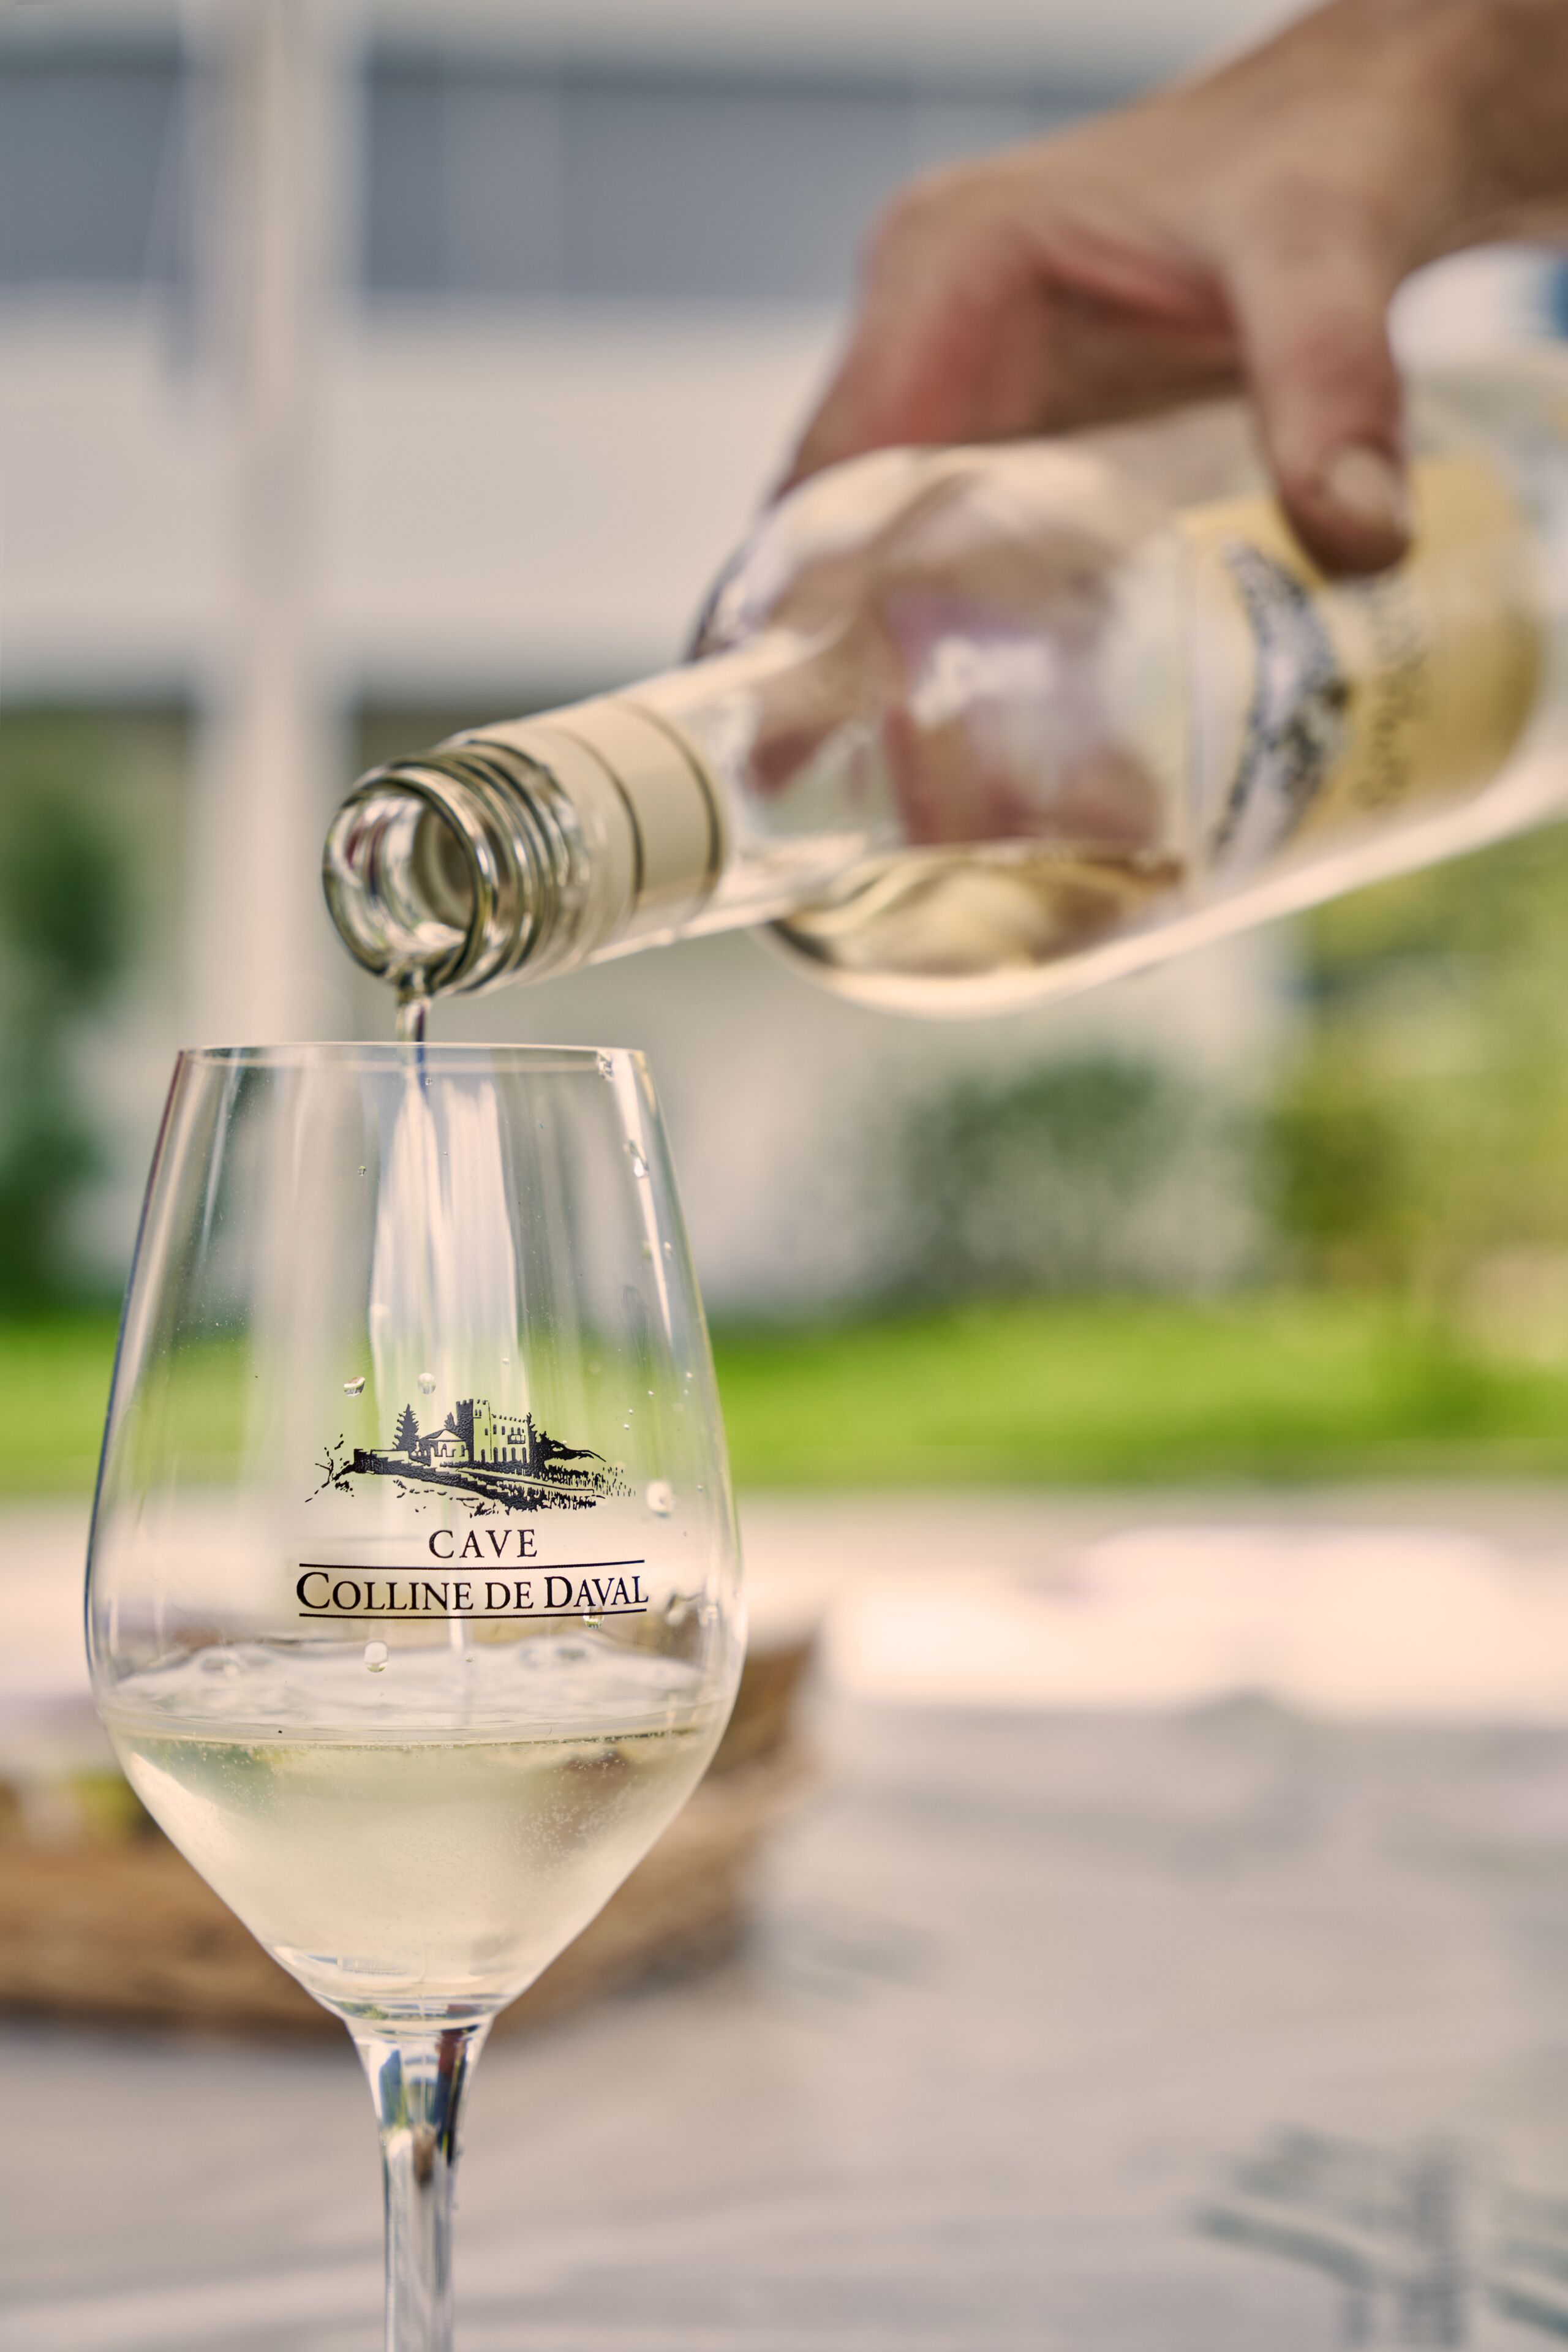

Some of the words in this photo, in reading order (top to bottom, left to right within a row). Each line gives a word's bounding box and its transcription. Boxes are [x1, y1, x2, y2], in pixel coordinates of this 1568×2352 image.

[429, 1529, 537, 1559] CAVE
[296, 1571, 473, 1610] COLLINE
[484, 1581, 534, 1610] DE
[543, 1575, 649, 1608] DAVAL
